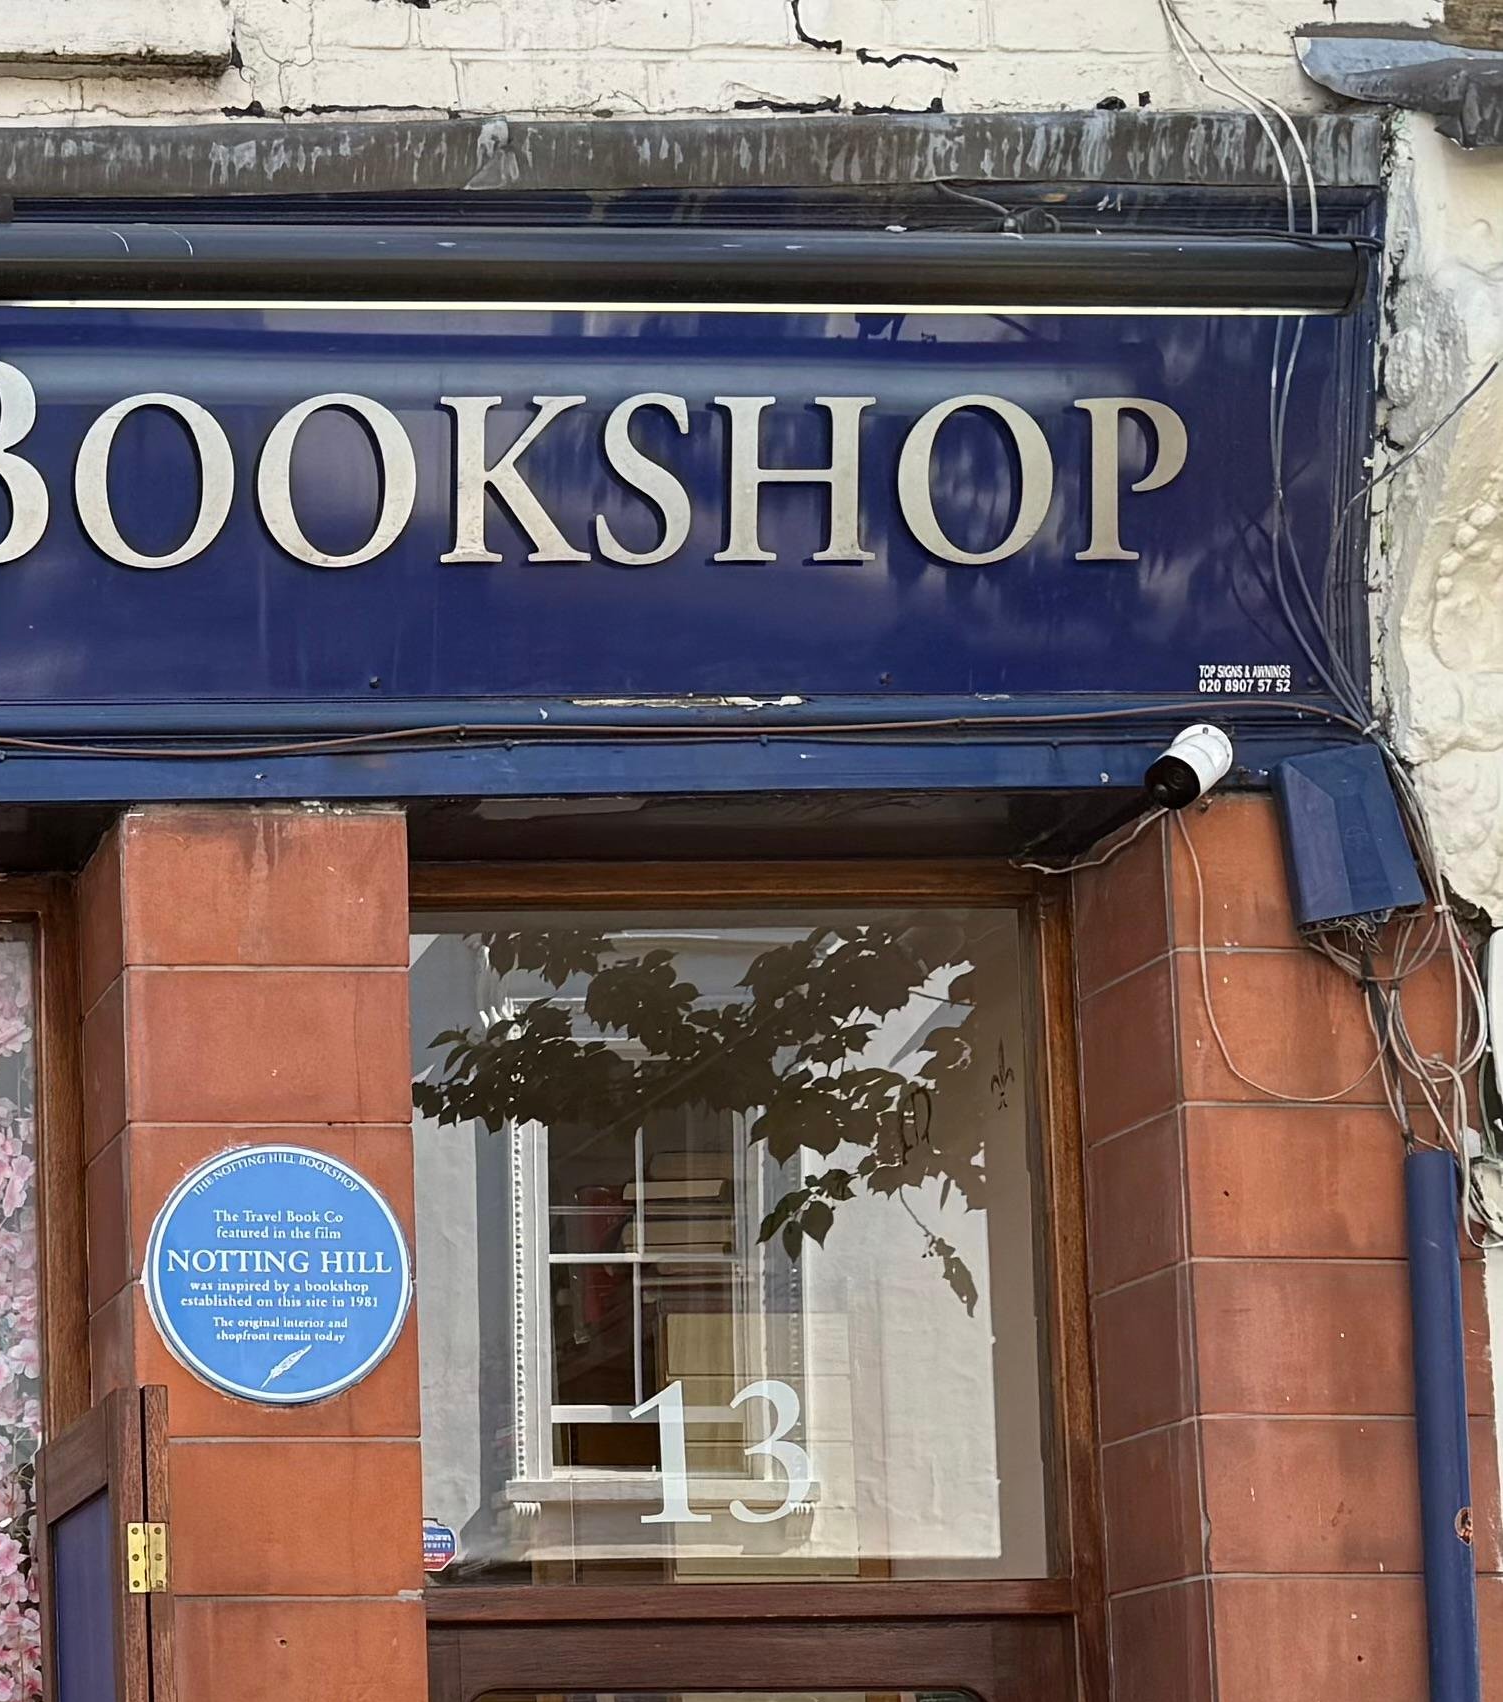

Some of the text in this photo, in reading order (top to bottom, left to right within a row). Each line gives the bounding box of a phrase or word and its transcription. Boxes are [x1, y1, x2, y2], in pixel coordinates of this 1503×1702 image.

[1199, 665, 1291, 678] TOP SIGNS & AWNINGS
[1199, 679, 1291, 692] 020 8907 57 52
[193, 1153, 360, 1195] THE NOTTING HILL BOOKSHOP
[213, 1209, 344, 1223] The Travel Book Co
[216, 1226, 341, 1239] featured in the film
[167, 1249, 392, 1274] NOTTING HILL
[190, 1279, 369, 1297] was inspired by a bookshop
[181, 1296, 378, 1308] established on this site in 1981
[213, 1317, 348, 1330] The original interior and
[216, 1331, 346, 1343] shopfront remain today
[629, 1380, 813, 1524] 13
